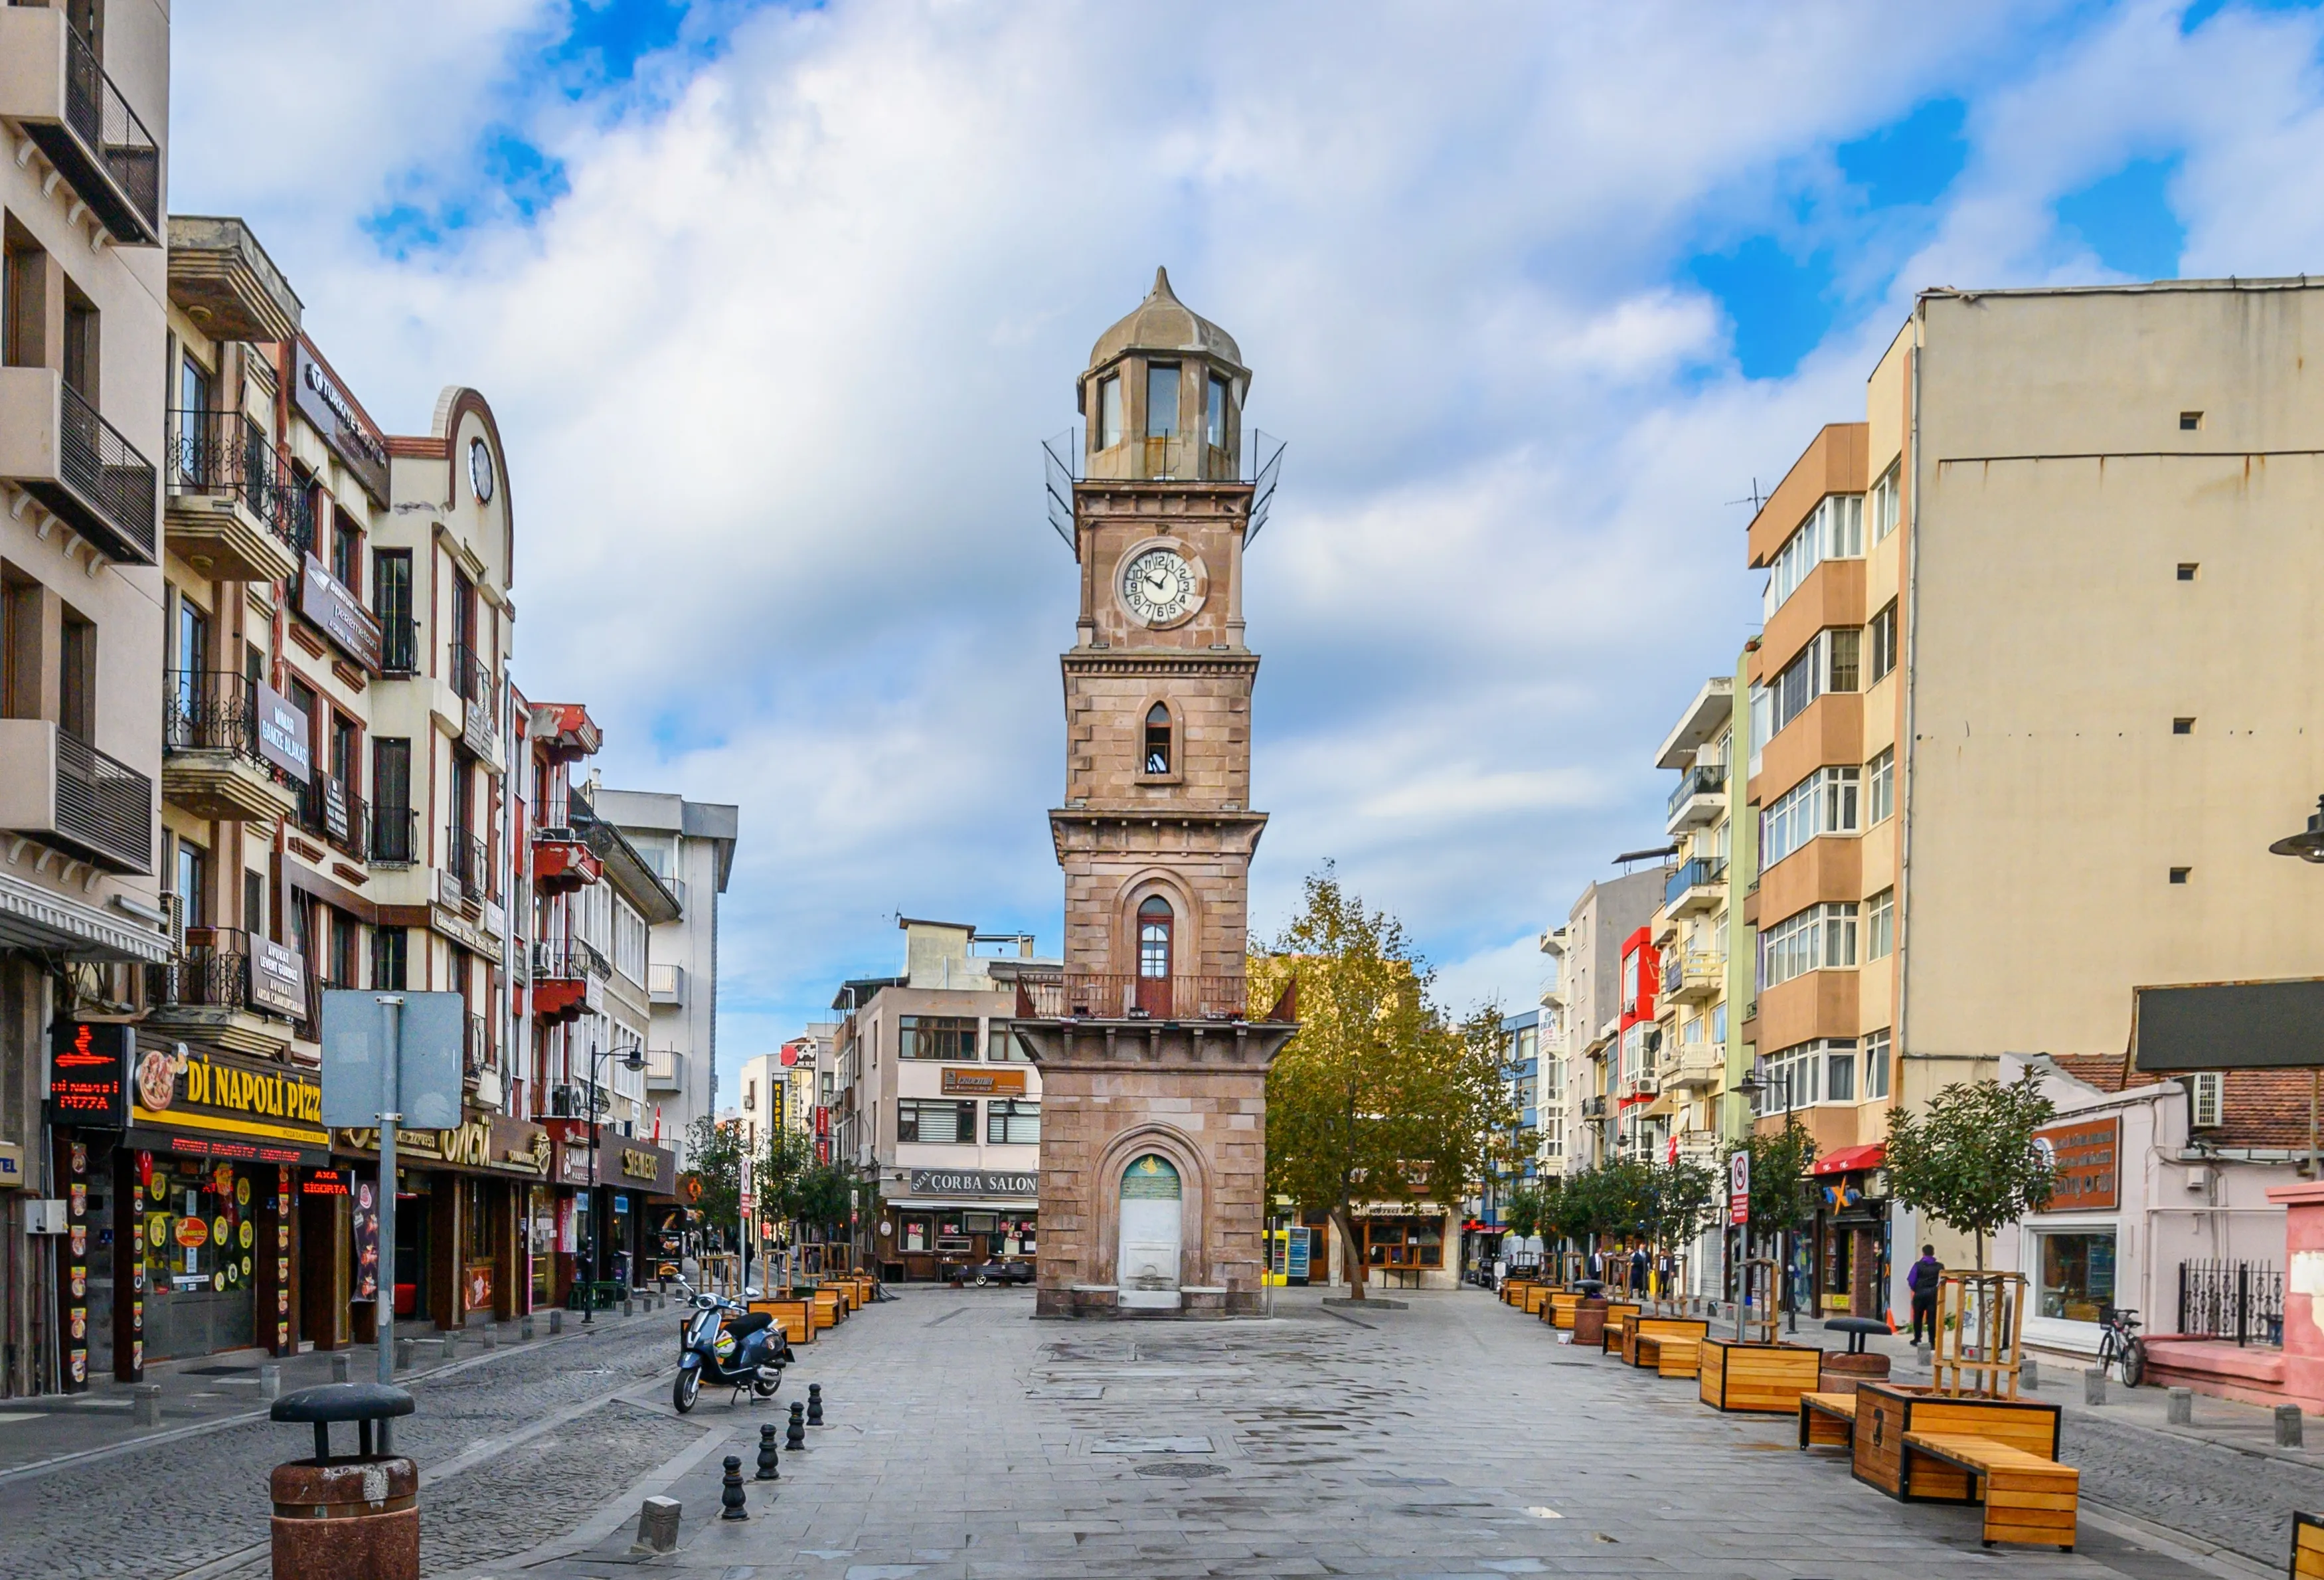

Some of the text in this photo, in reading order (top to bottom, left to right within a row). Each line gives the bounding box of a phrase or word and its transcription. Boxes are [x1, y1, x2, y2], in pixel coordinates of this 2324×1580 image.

[1144, 560, 1151, 570] 11
[1133, 569, 1142, 579] 10
[1179, 569, 1186, 578] 2
[1130, 582, 1137, 592] 9
[1183, 581, 1190, 591] 3
[1134, 595, 1141, 605] 8
[1179, 595, 1186, 604] 4
[1145, 604, 1152, 614] 7
[1157, 607, 1163, 617] 6
[1169, 604, 1176, 614] 5
[274, 706, 294, 736] MİMAR
[262, 719, 307, 770] GAMZE ALAKAŞ
[268, 944, 290, 964] AVUKAT
[260, 955, 297, 982] LEVENT GÜRBÜZ
[270, 979, 291, 996] AVUKAT
[256, 987, 305, 1014] ARDA CANKURTARAN
[188, 1053, 321, 1124] Dİ NAPOLİ PİZZ
[623, 1148, 658, 1181] SIEMENS
[315, 1171, 338, 1180] AXA
[912, 1170, 1039, 1191] ÖZEL ÇORBA SALON
[303, 1182, 347, 1194] SİGORTA
